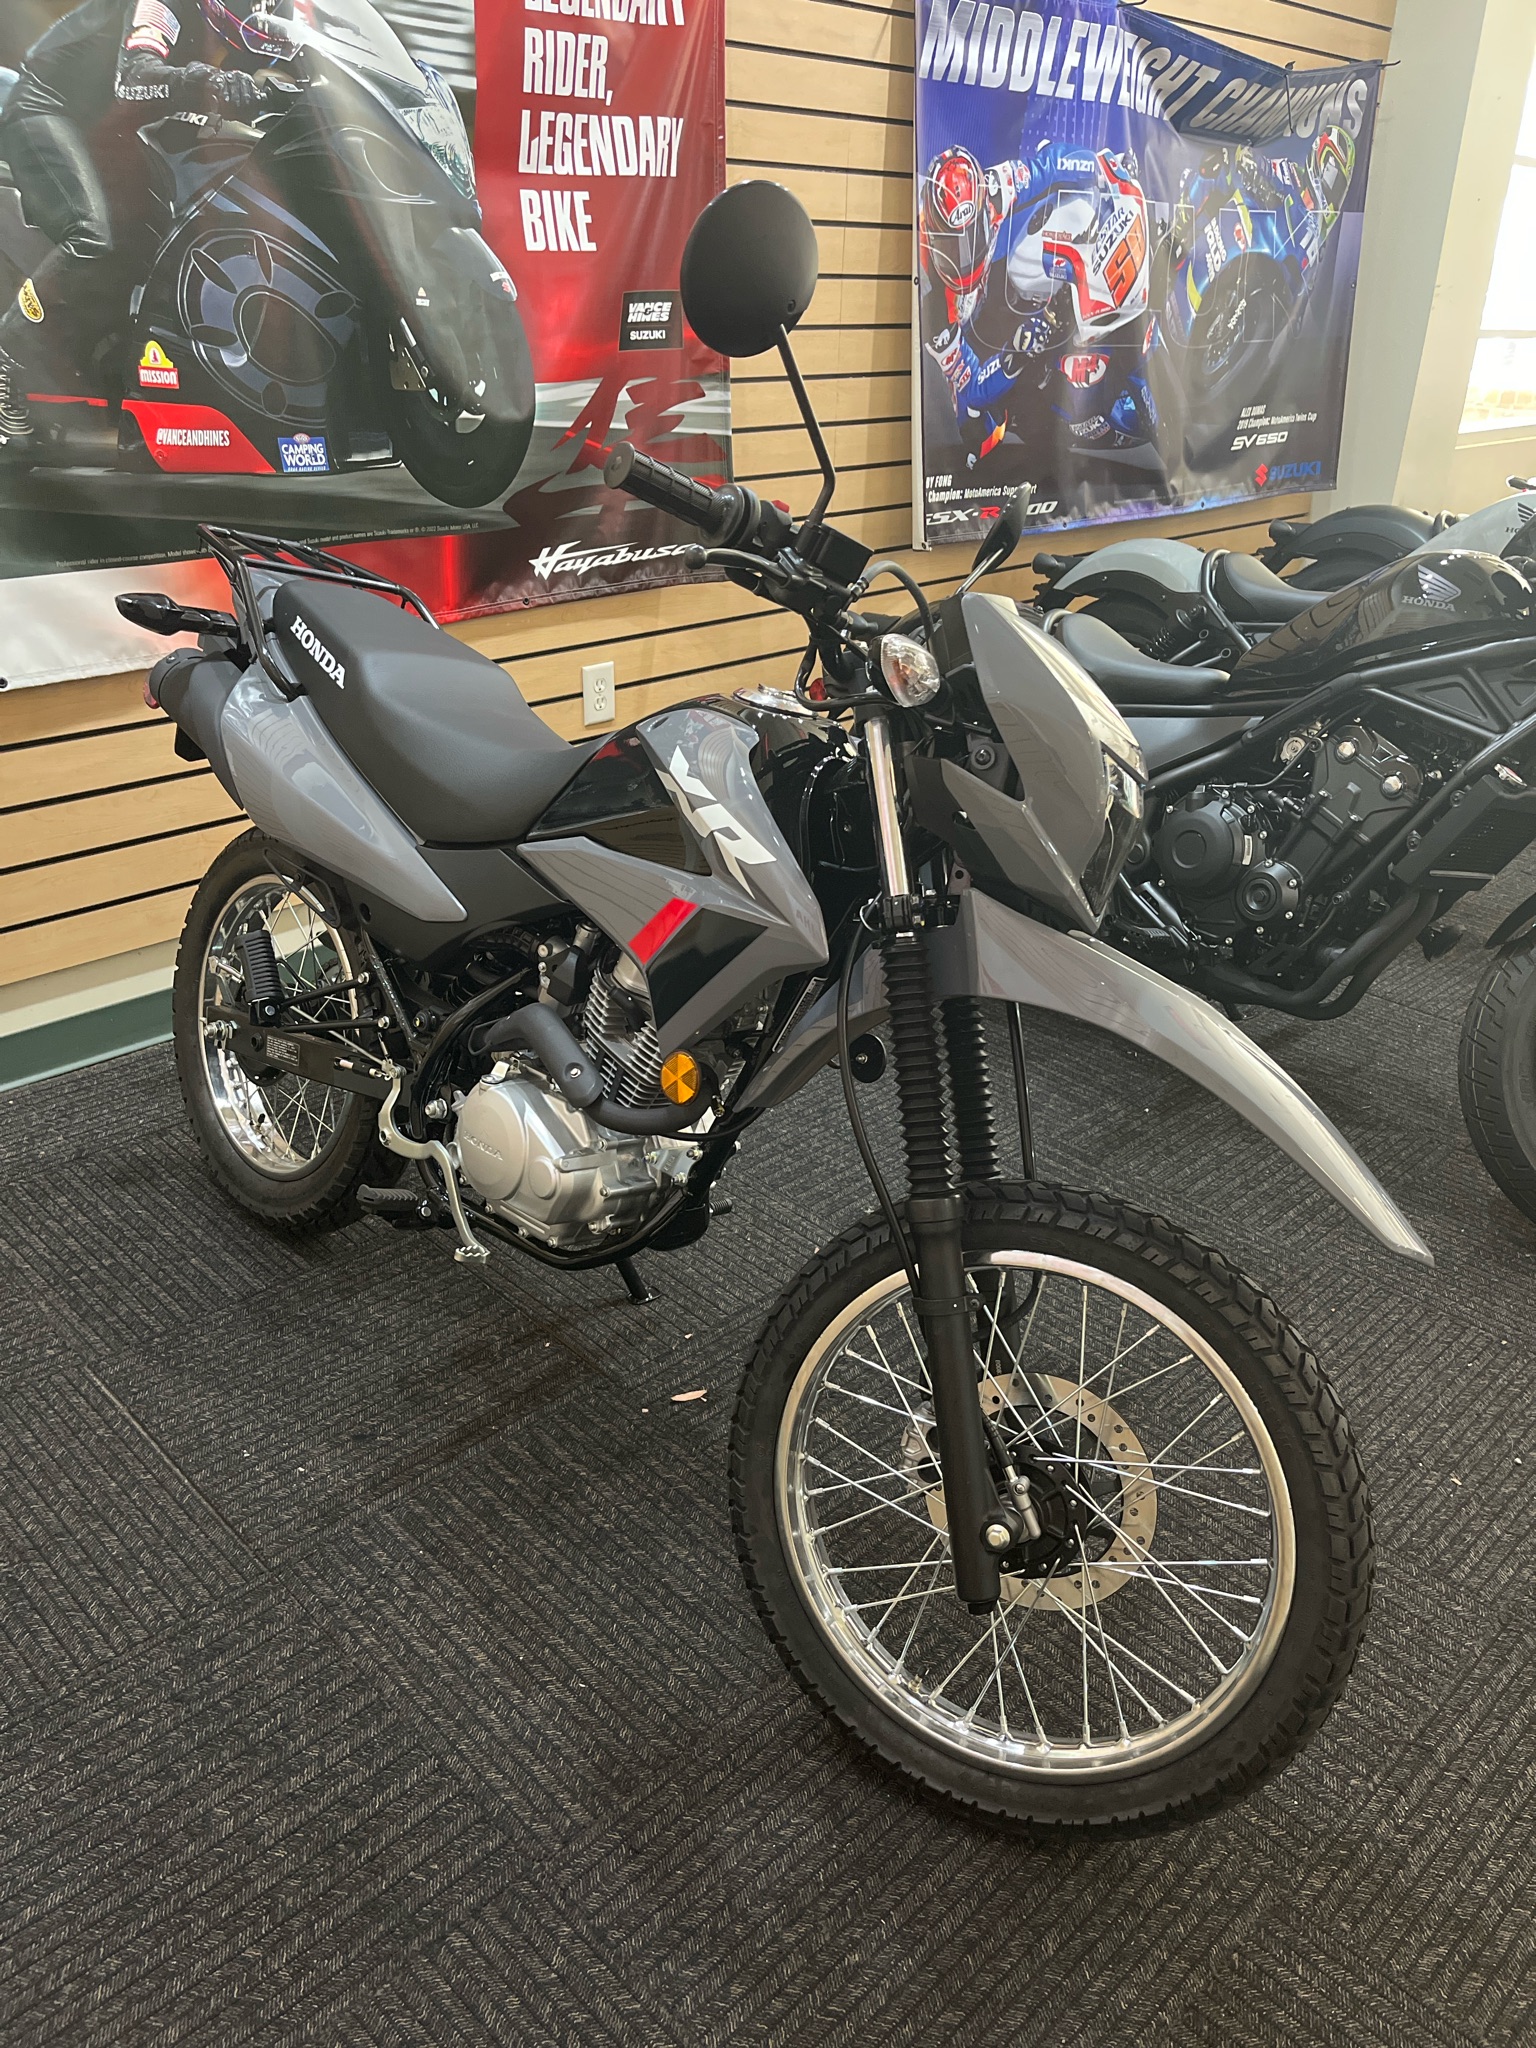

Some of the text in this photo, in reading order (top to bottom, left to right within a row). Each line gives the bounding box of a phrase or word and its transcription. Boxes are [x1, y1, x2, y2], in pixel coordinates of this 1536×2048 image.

[523, 27, 613, 106] RIDER,
[918, 0, 1221, 121] MIDDLEWEIGHT
[174, 111, 209, 126] ZUKI
[518, 109, 684, 178] LEGENDARY
[519, 188, 597, 251] BIKE
[1092, 210, 1135, 277] SUZUKI
[628, 301, 672, 313] VANCE
[627, 311, 670, 323] HINES
[629, 329, 666, 341] SUZUKI
[1307, 411, 1317, 422] Cup
[156, 428, 230, 447] @VANCEANDHINES
[1230, 431, 1288, 451] SV650
[281, 443, 324, 454] CAMPING
[283, 454, 326, 466] WORLD
[1269, 461, 1322, 481] SUZUKI
[934, 474, 953, 488] FONG
[928, 488, 963, 504] Champion:
[964, 485, 1002, 499] MotoAmerica
[1401, 595, 1456, 612] HONDA
[290, 615, 346, 690] HONDA
